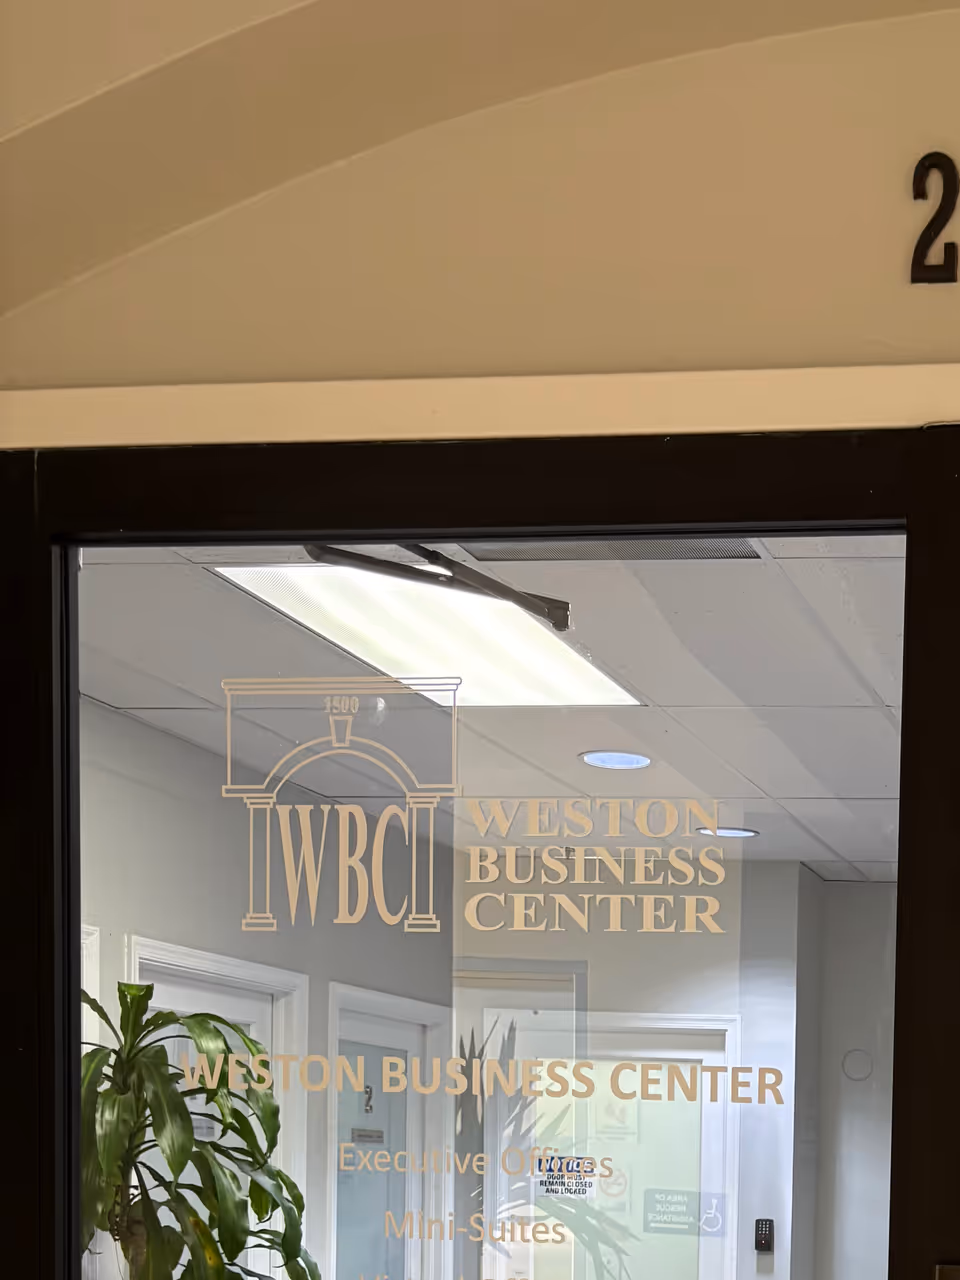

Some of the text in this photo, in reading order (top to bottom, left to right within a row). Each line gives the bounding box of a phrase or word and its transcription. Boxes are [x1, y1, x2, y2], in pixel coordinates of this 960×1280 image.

[323, 695, 359, 714] 1500
[467, 799, 724, 838] WESTON
[276, 804, 409, 927] WBC
[465, 846, 726, 886] BUSINESS
[464, 892, 726, 933] CENTER
[181, 1054, 785, 1105] WESTON BUSINESS CENTER
[339, 1143, 614, 1180] Executive Offices
[385, 1210, 566, 1245] Mini-Suites
